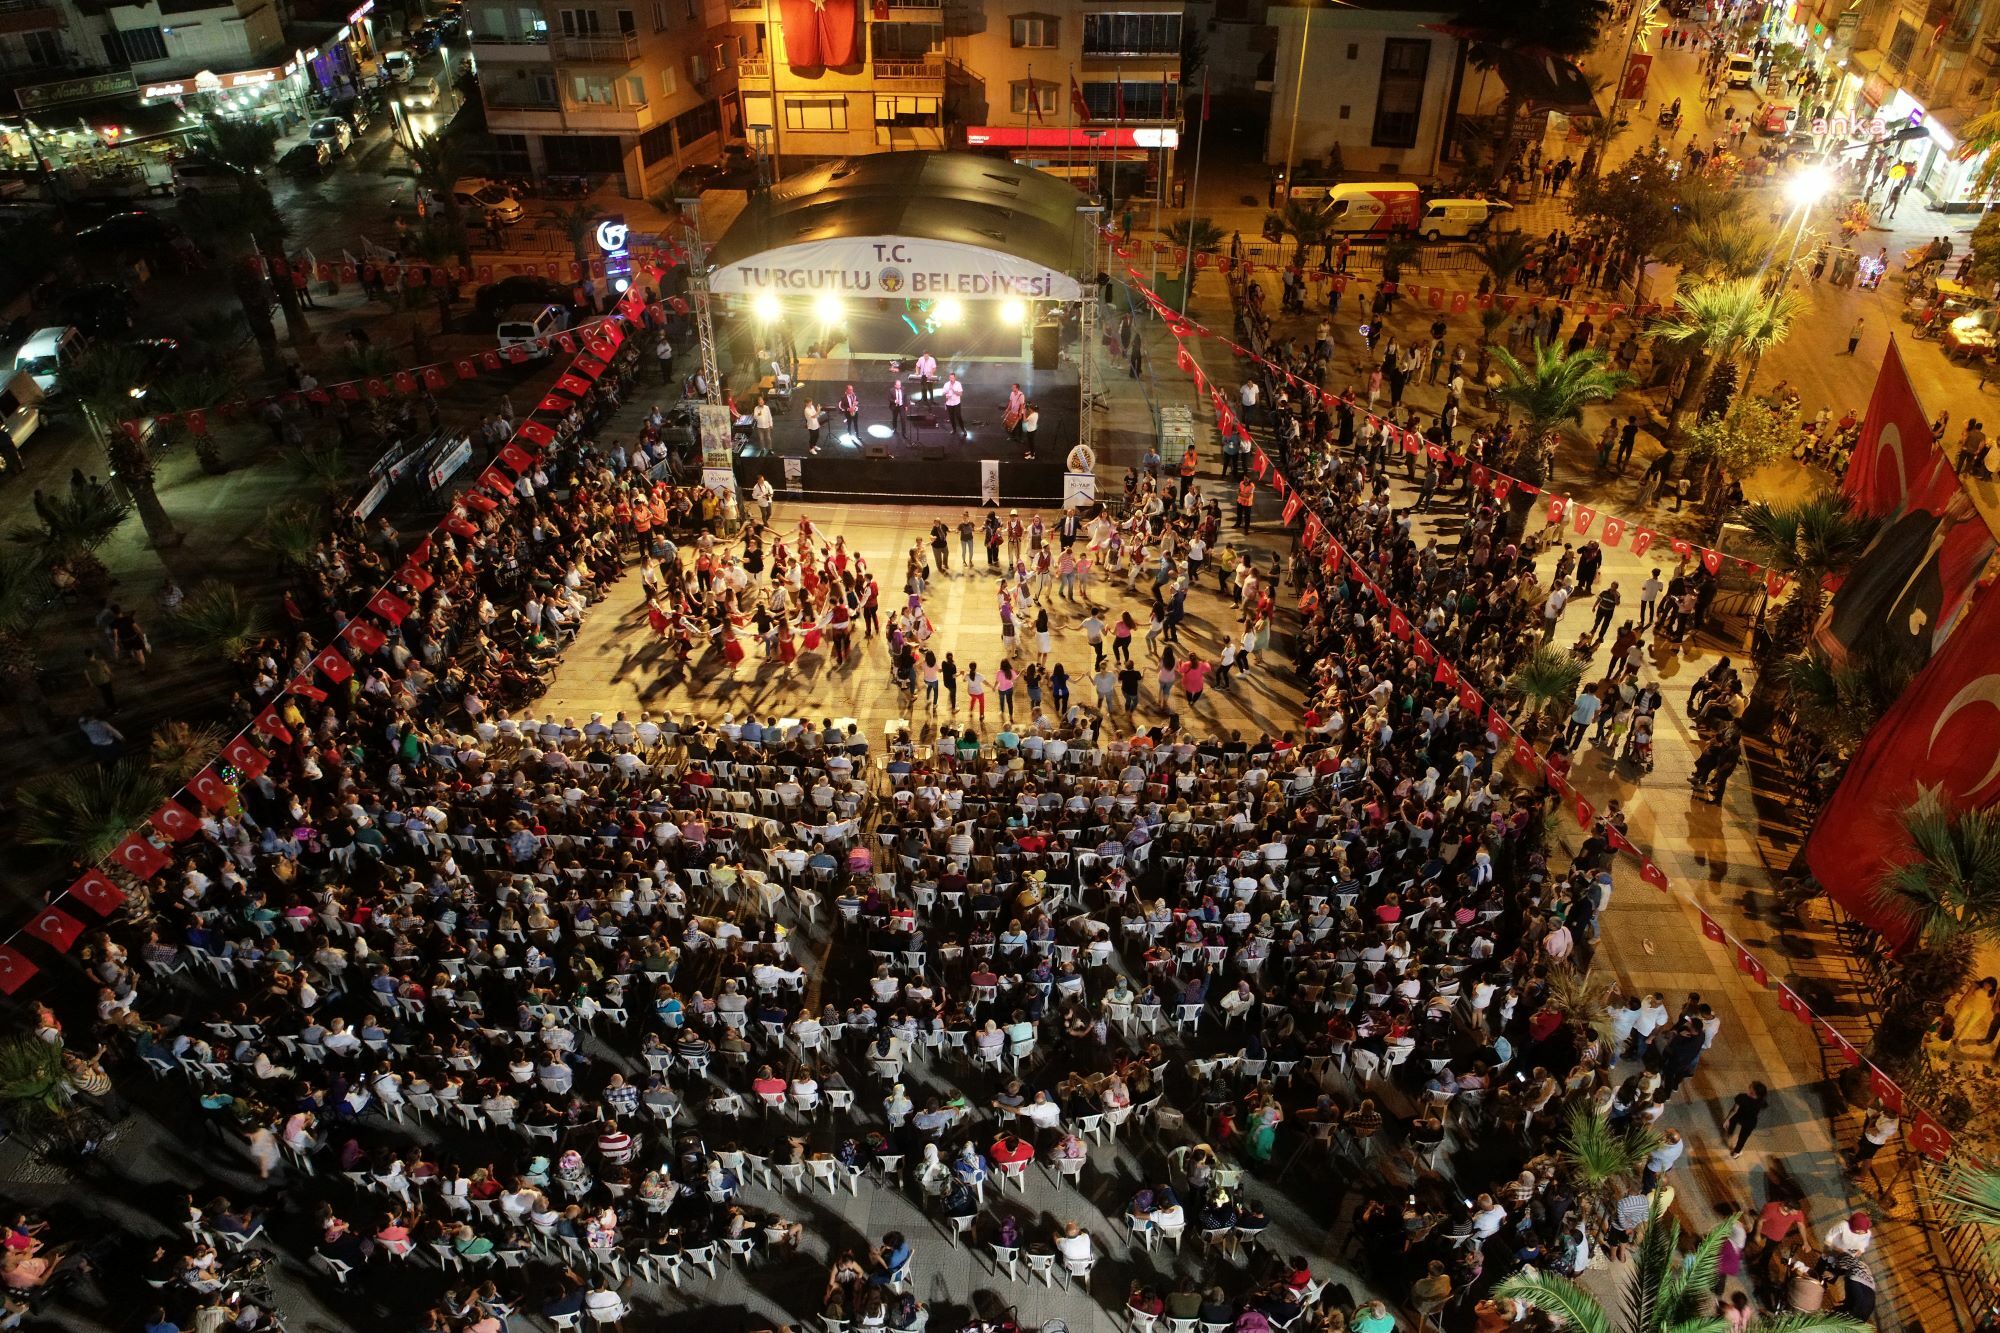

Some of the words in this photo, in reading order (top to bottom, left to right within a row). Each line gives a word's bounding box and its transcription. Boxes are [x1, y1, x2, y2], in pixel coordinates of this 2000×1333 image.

[873, 244, 912, 263] T.C.
[738, 267, 871, 291] TURGUTLU
[912, 270, 1051, 297] BELEDİYESİ
